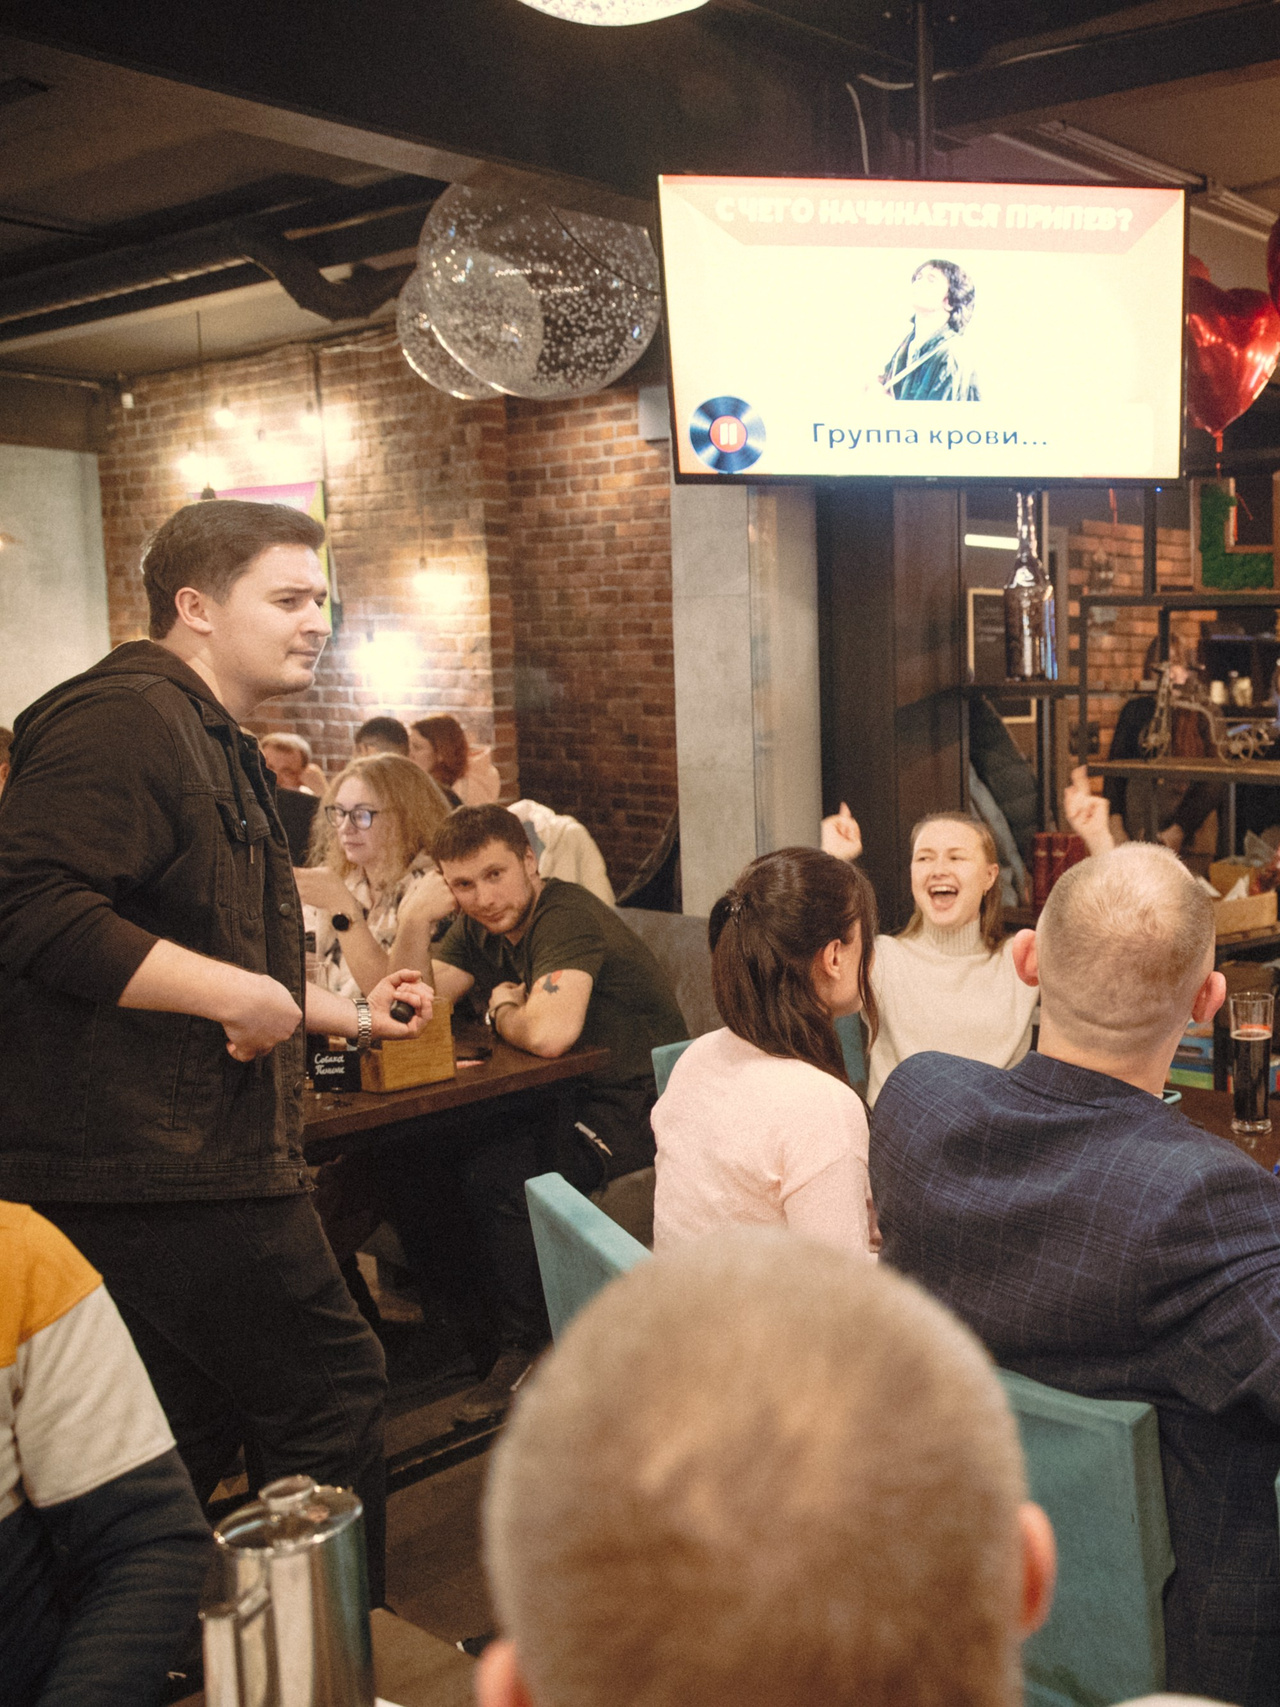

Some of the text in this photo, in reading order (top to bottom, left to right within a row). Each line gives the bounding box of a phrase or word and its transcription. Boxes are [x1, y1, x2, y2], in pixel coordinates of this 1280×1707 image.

[714, 197, 1134, 232] С ЧЕГО НАЧИНАЕТСЯ ПРИПЕВ?
[813, 423, 1047, 450] Группа крови...
